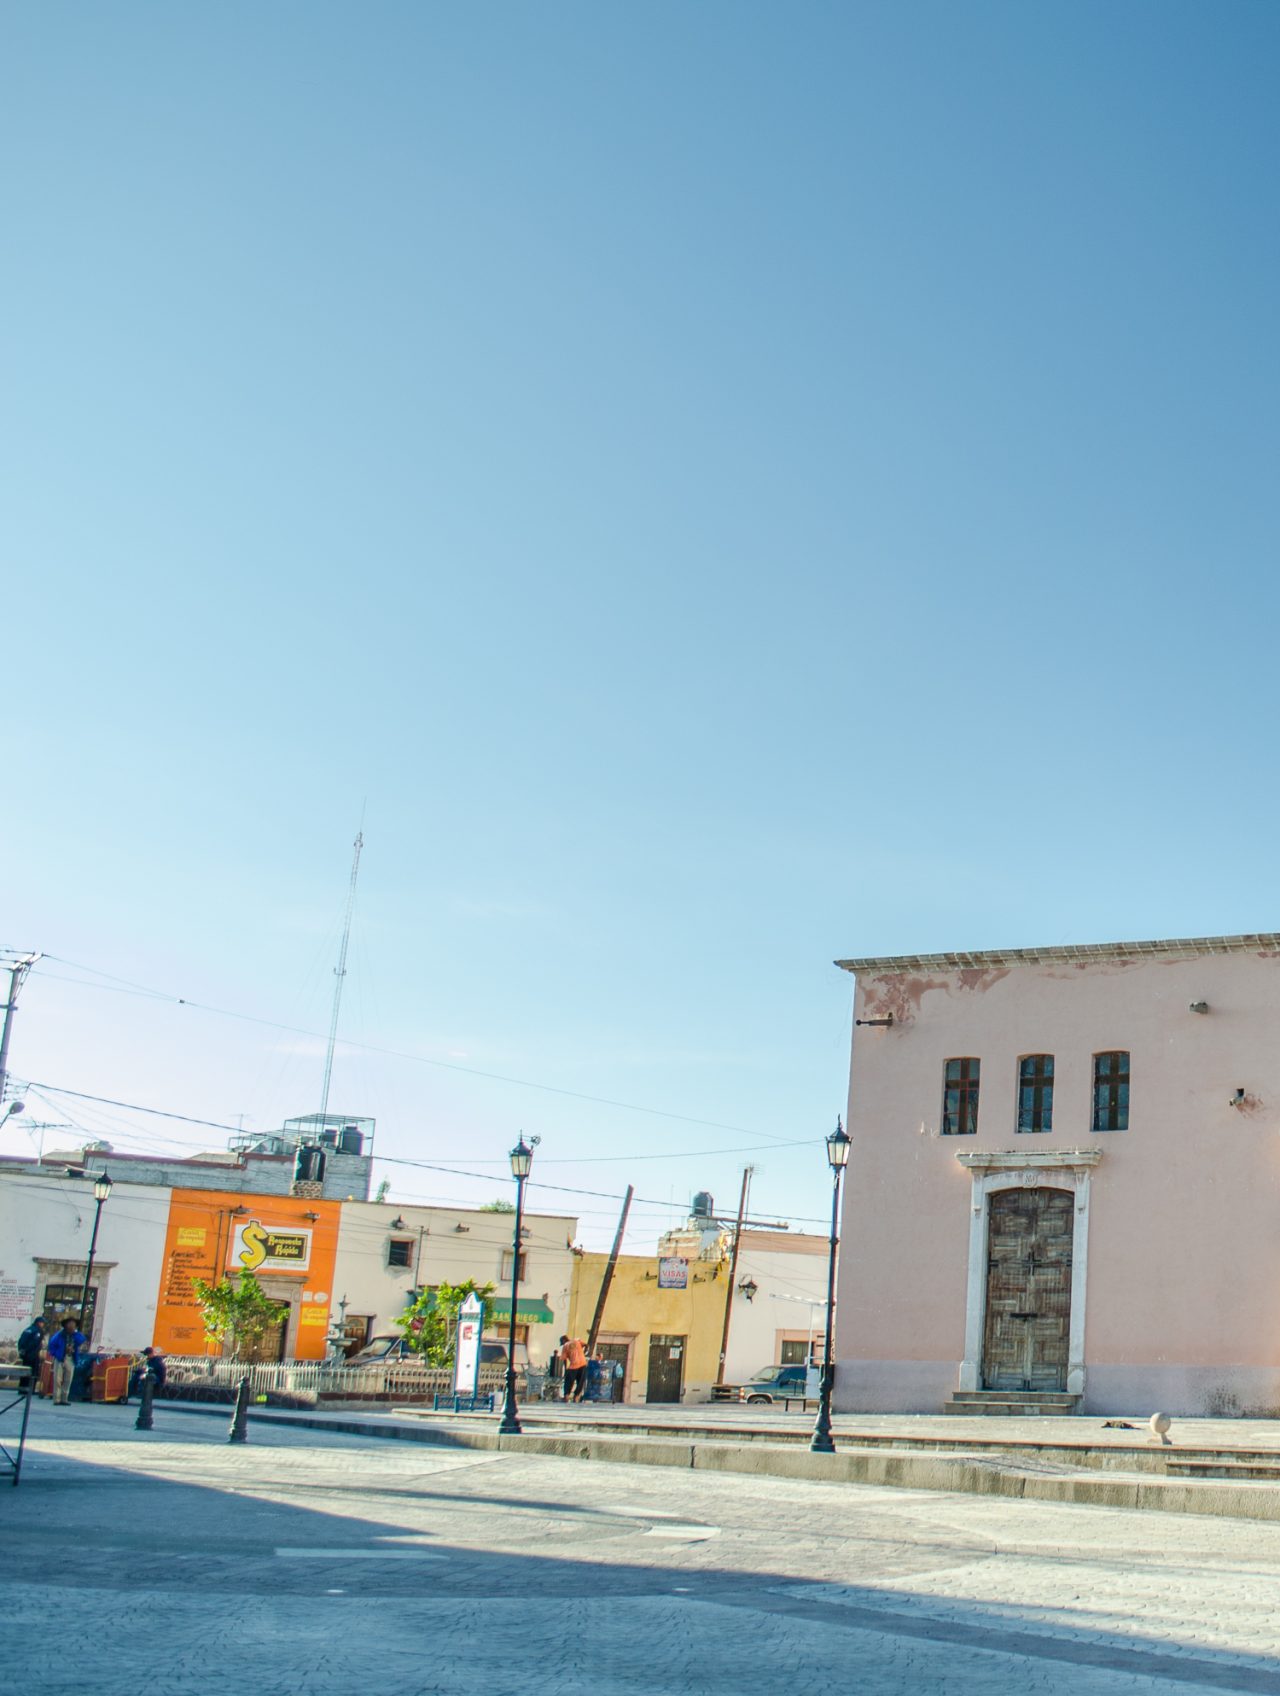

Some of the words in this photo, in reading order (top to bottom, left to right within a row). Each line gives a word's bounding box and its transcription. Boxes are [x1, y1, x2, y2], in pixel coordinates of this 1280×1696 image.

[267, 1235, 302, 1246] Respuesta
[662, 1271, 686, 1280] VISAS
[491, 1311, 511, 1321] SAN
